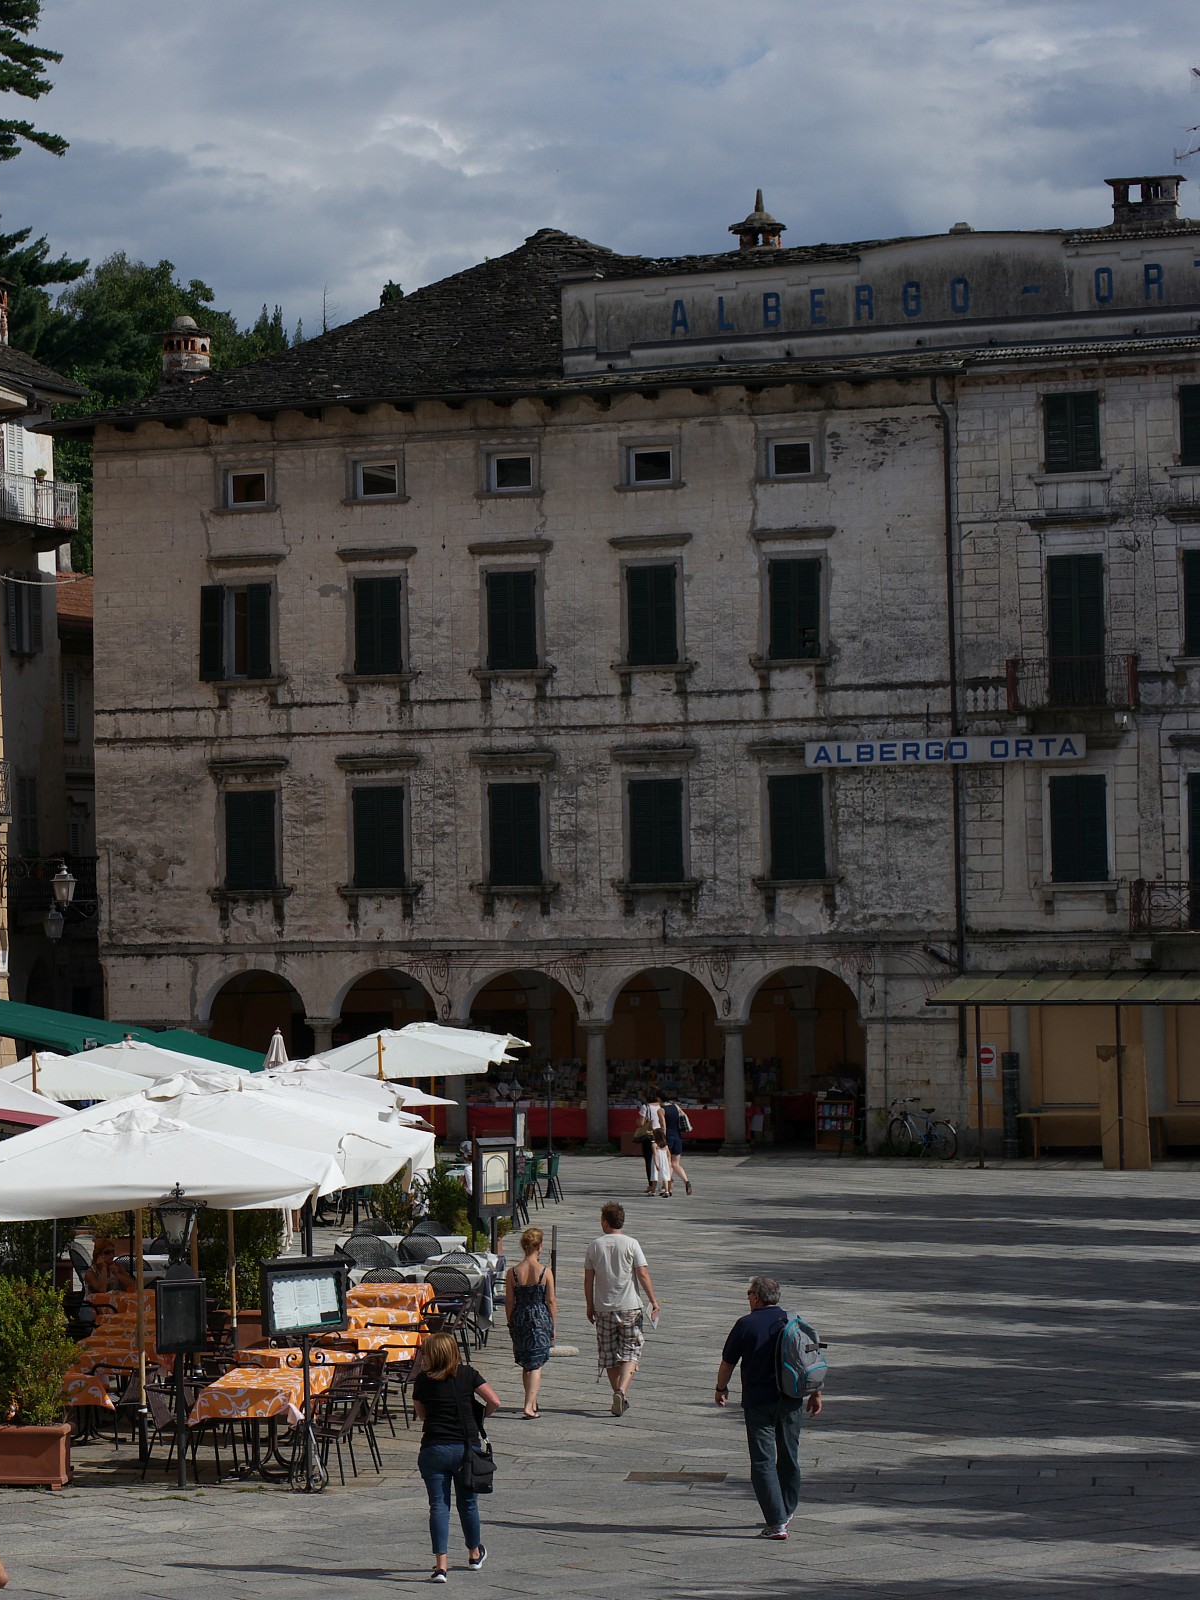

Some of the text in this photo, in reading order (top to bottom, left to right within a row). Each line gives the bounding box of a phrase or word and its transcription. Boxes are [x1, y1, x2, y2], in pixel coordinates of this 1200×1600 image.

[670, 277, 970, 334] ALBERGO
[1094, 260, 1200, 303] OR
[813, 738, 1078, 764] ALBERGO ORTA
